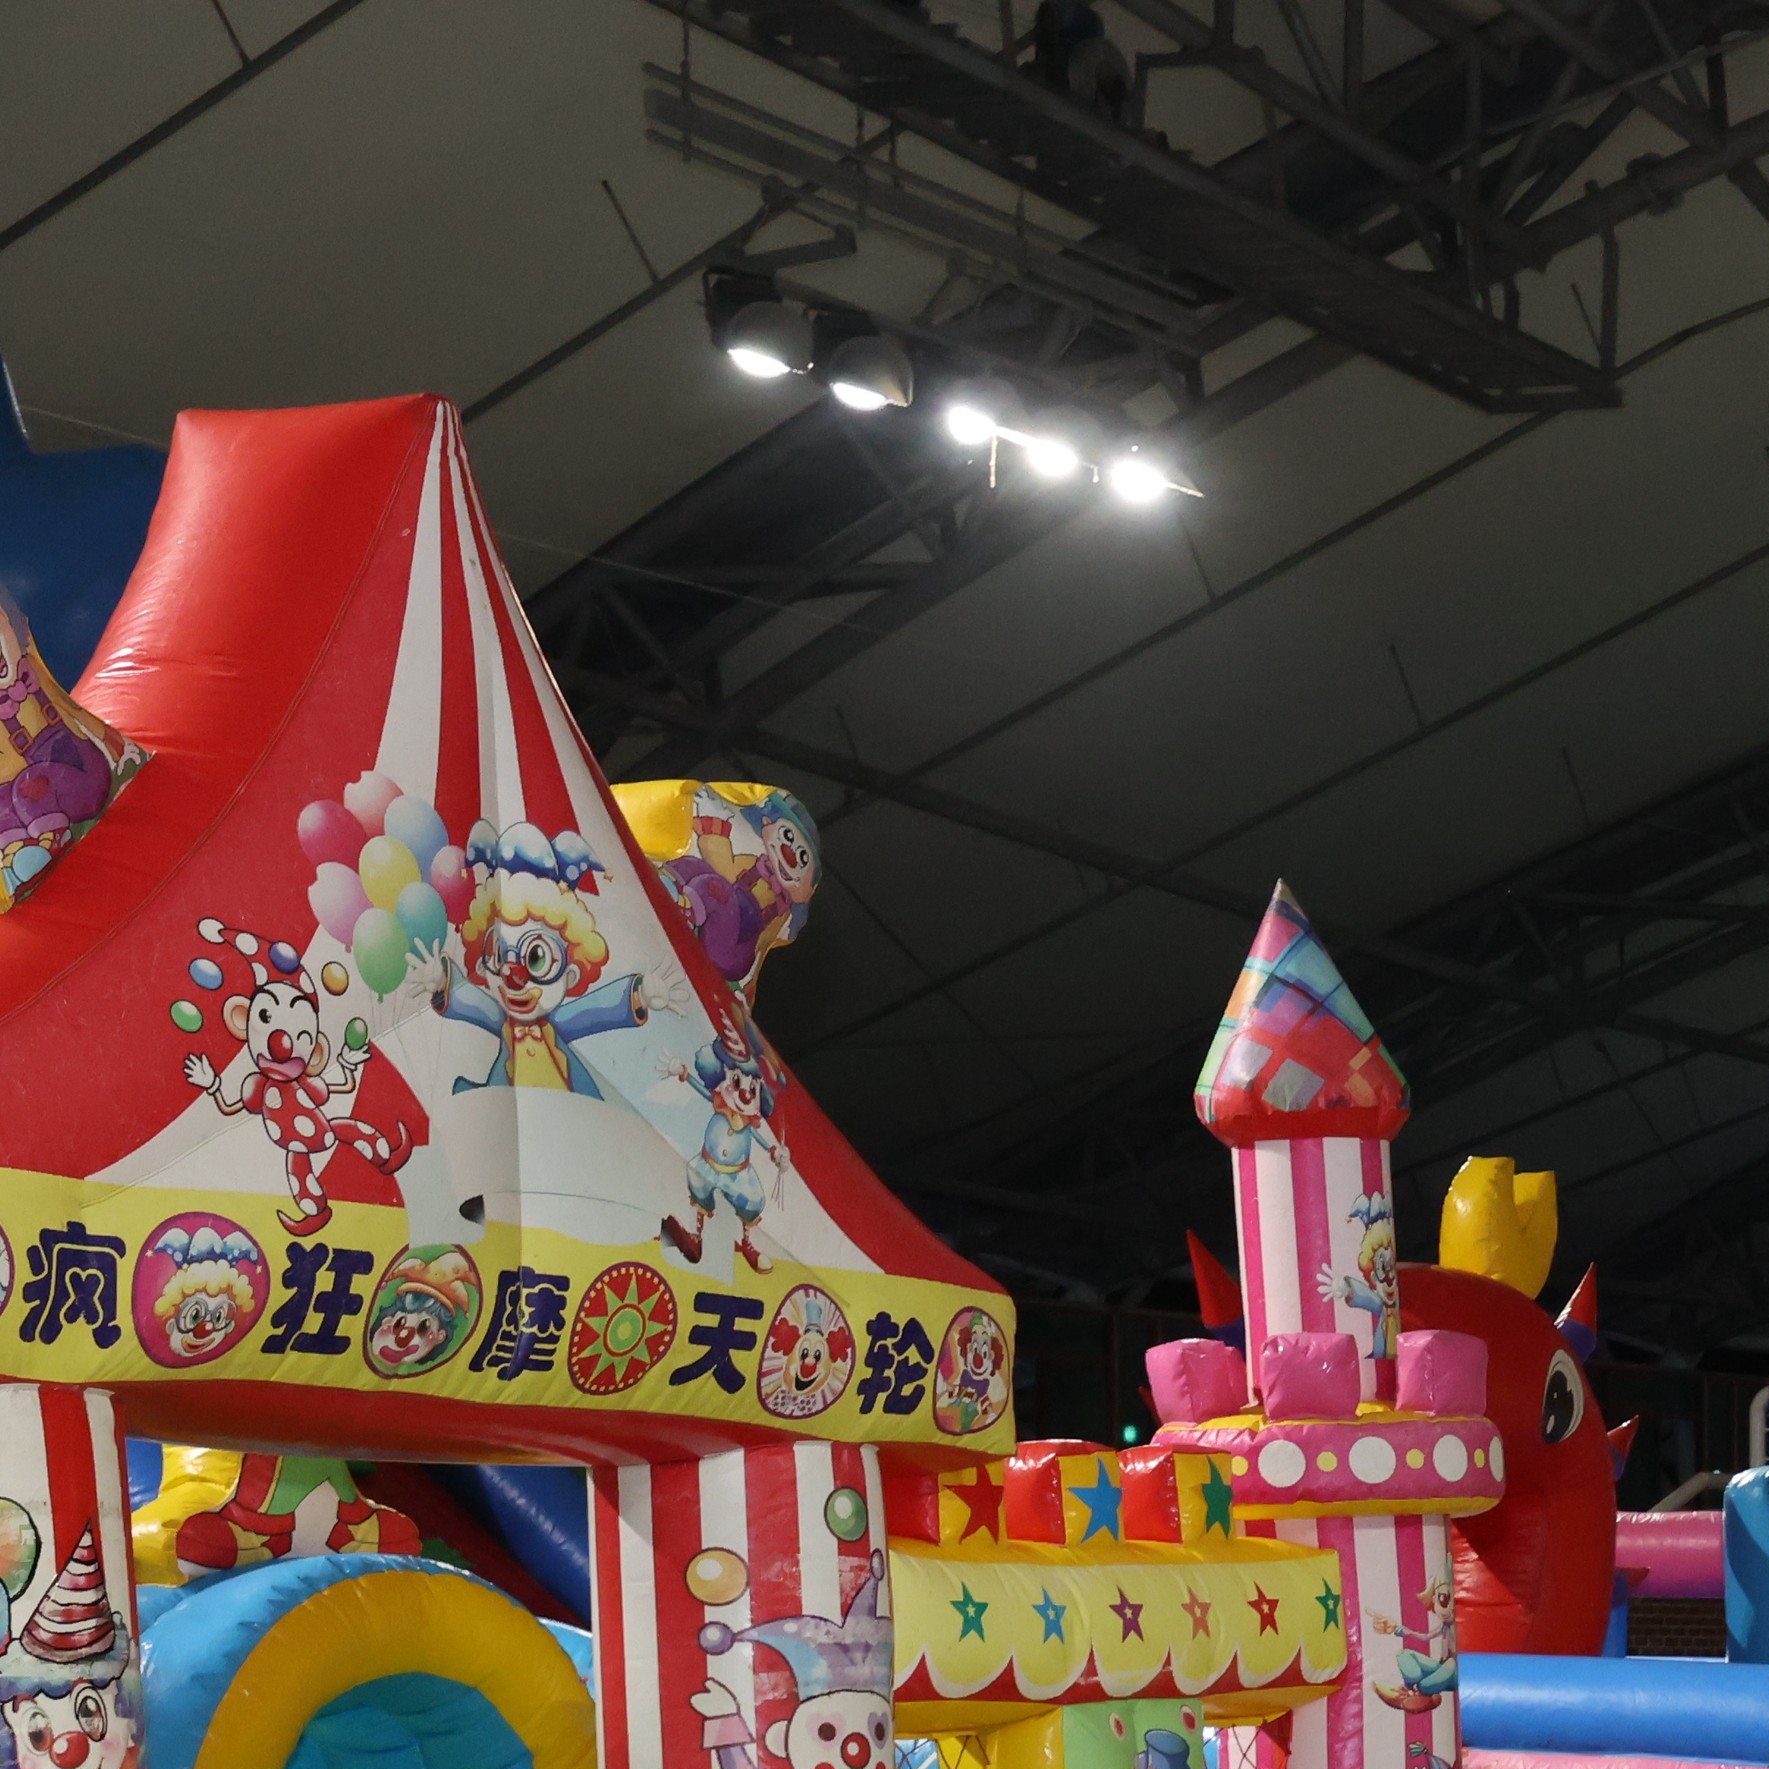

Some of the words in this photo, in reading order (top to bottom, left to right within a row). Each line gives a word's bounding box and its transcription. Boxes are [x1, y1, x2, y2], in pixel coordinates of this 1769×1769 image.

[22, 1220, 936, 1416] 疯狂摩天轮
